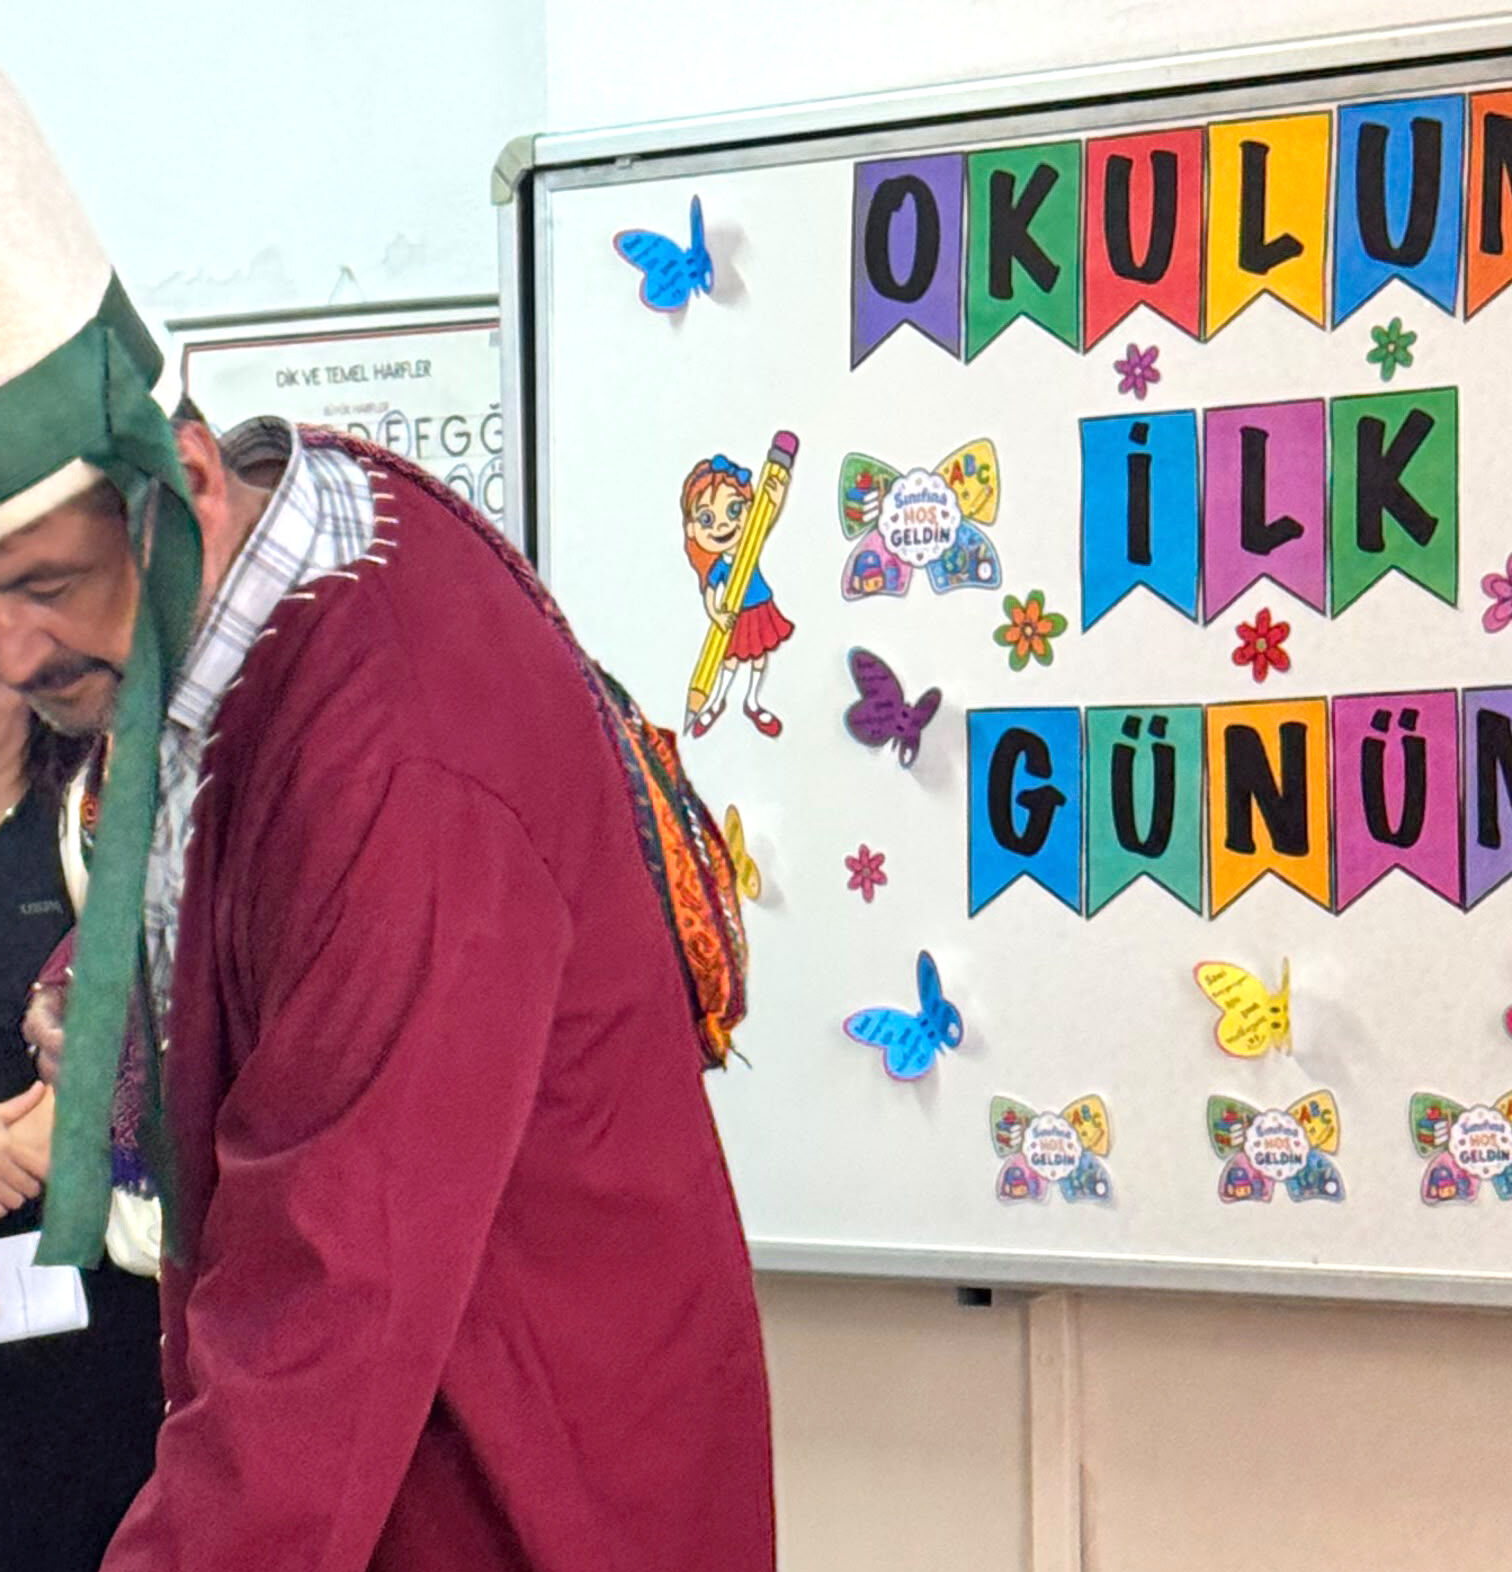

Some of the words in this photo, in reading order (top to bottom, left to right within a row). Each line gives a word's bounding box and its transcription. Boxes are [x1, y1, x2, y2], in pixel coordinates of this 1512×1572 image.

[302, 366, 321, 386] VE
[324, 364, 369, 383] TEMEL
[373, 359, 432, 379] HARFLER
